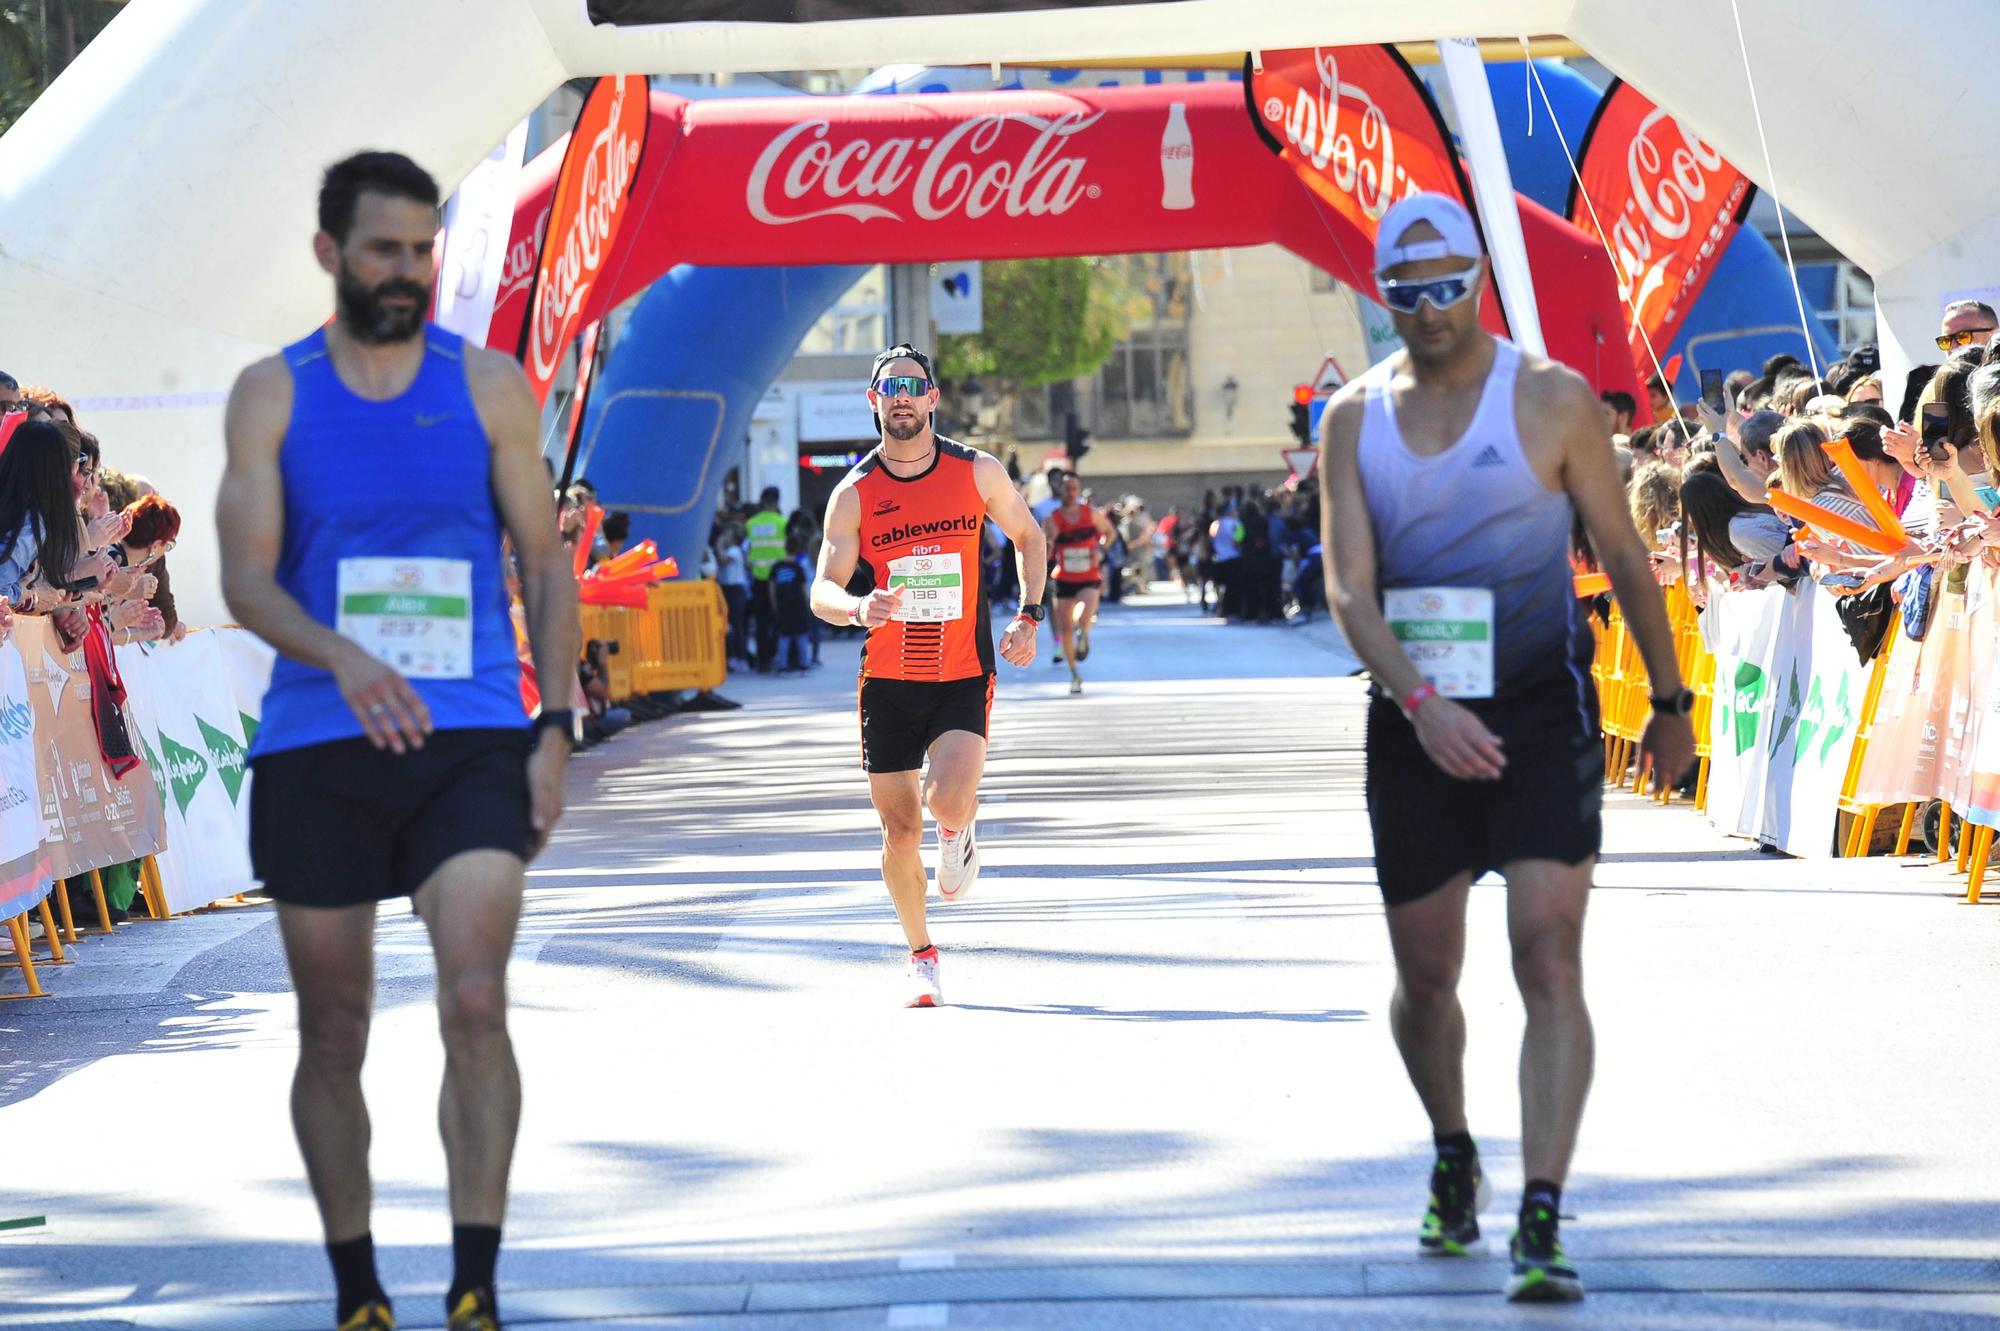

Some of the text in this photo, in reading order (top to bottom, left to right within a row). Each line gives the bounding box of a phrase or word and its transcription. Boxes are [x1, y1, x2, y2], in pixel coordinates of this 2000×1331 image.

[746, 110, 1104, 225] Coca-Cola
[532, 95, 629, 382] Coca-Cola
[871, 515, 977, 547] cableworld
[912, 544, 941, 556] fibra
[906, 577, 942, 587] Ruben
[912, 590, 938, 600] 138
